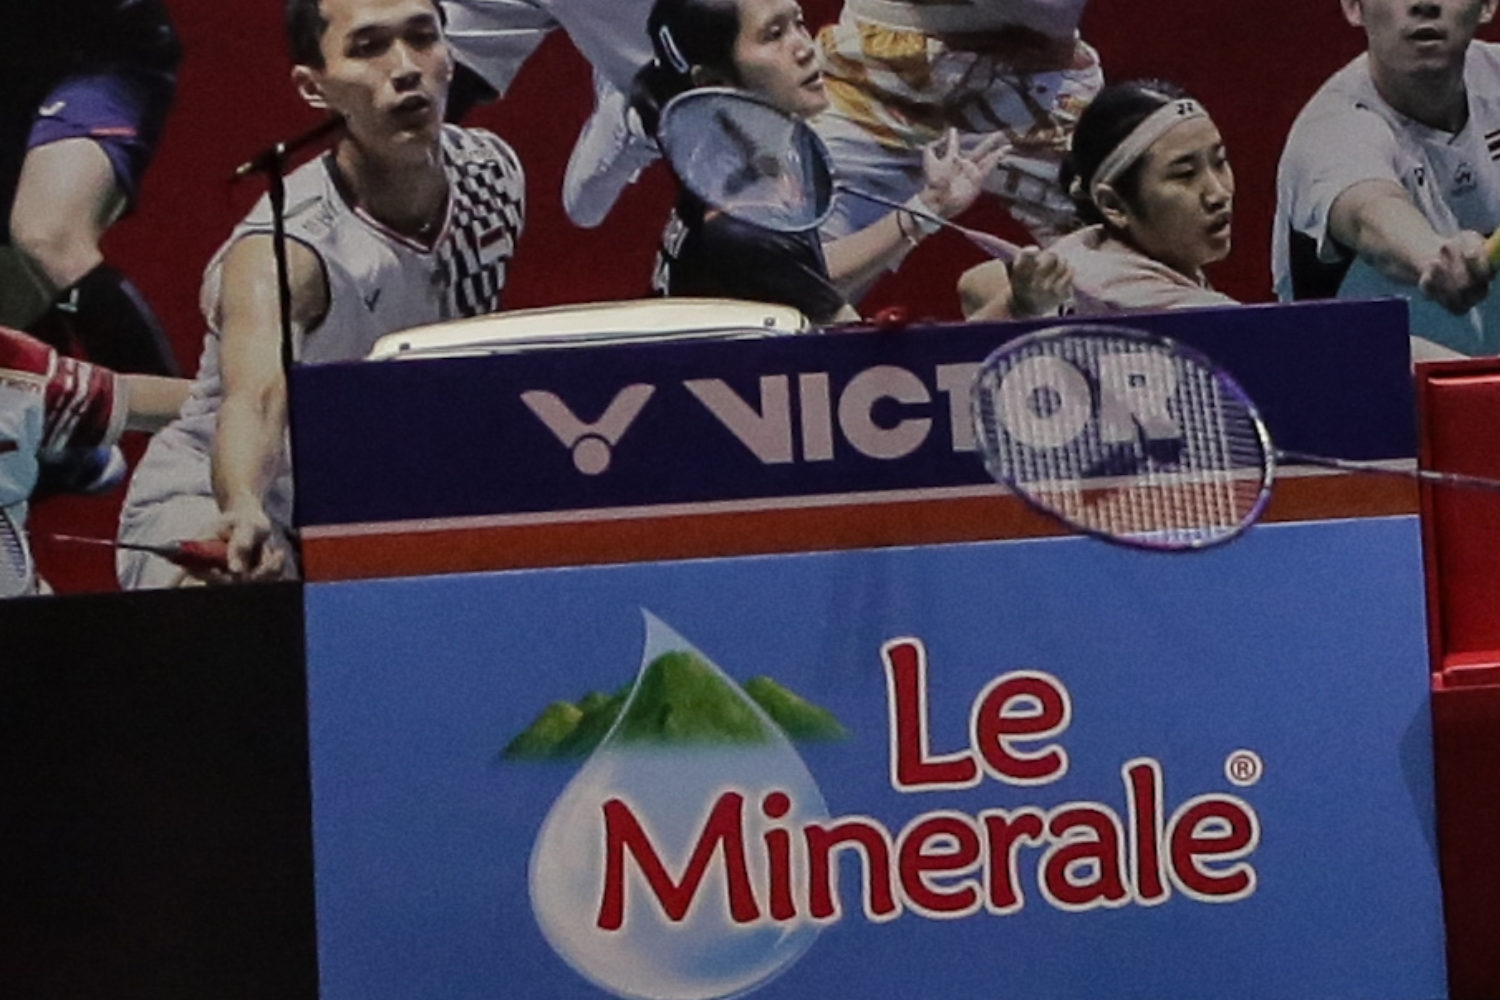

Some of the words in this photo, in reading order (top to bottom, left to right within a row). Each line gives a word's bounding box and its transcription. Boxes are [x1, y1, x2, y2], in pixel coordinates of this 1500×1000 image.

[684, 353, 1183, 465] VICTOR
[882, 638, 1068, 788] Le
[597, 762, 1257, 932] Minerale
